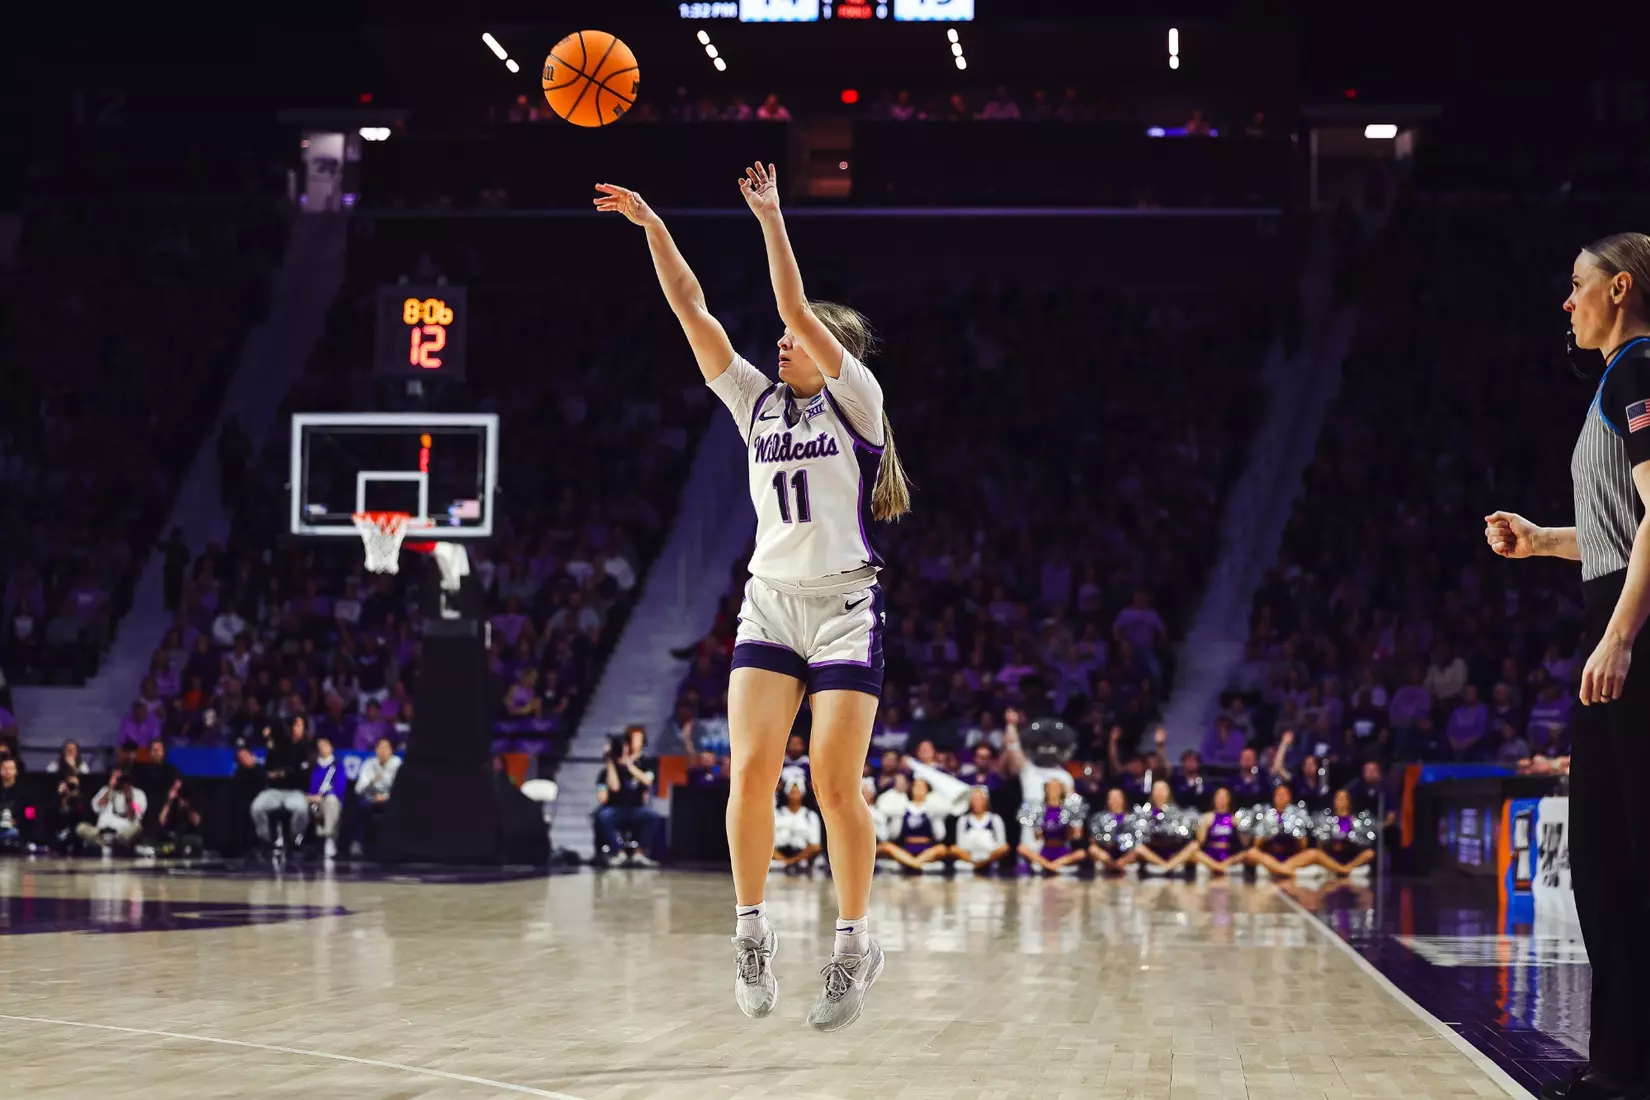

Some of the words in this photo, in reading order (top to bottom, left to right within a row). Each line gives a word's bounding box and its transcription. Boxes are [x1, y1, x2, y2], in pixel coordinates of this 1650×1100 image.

[403, 298, 454, 325] 8:06
[410, 325, 446, 368] 12
[754, 431, 839, 464] Wildcats
[772, 469, 811, 523] 11
